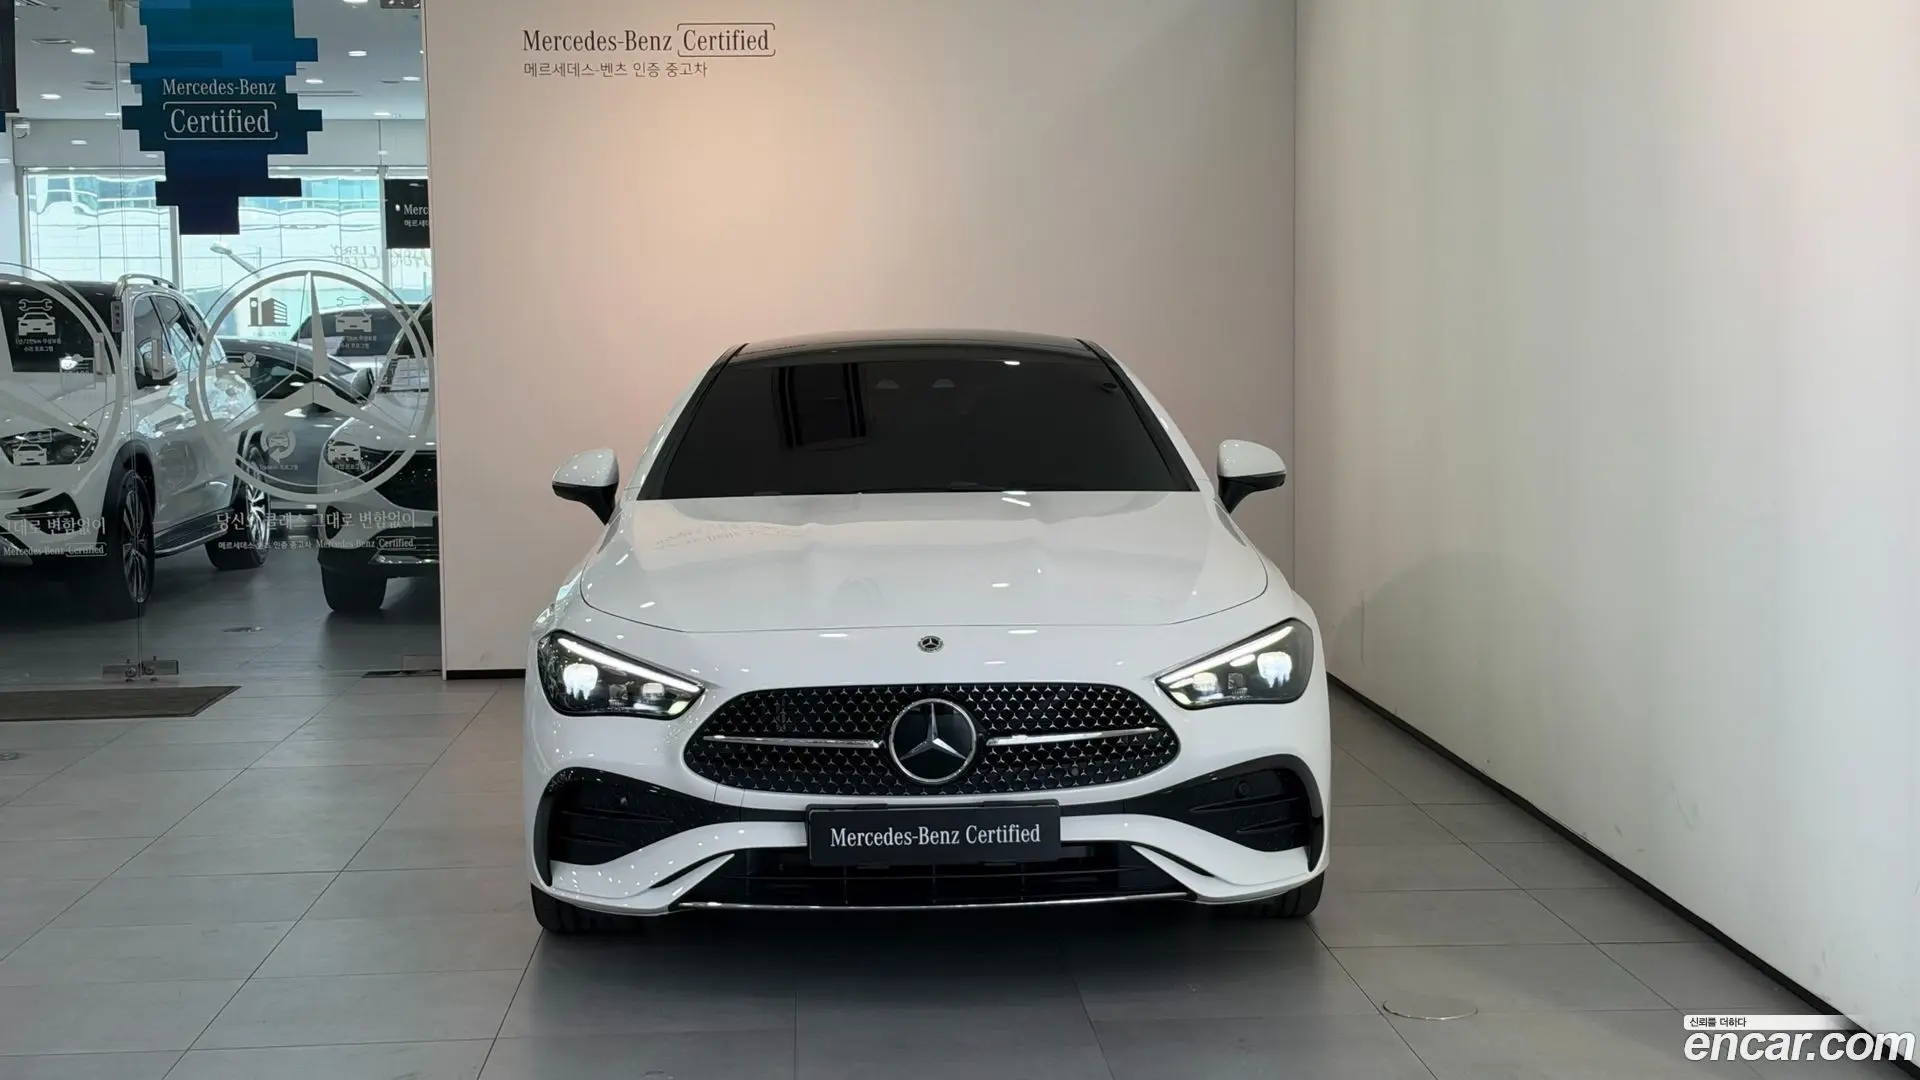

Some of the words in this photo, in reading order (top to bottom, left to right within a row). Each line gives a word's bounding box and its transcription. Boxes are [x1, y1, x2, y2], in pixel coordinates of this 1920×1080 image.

[523, 29, 672, 52] Mercedes-Benz
[683, 29, 769, 51] Certified
[524, 62, 628, 78] 메르세데스-벤츠
[633, 62, 660, 78] 인증
[665, 61, 708, 78] 중고차
[162, 78, 276, 95] Mercedes-Benz
[170, 108, 271, 133] Certified
[403, 203, 430, 215] Merc
[359, 510, 415, 529] 변함없이
[378, 538, 415, 549] Certified
[830, 826, 960, 848] Mercedes-Benz
[965, 824, 1041, 844] Certified
